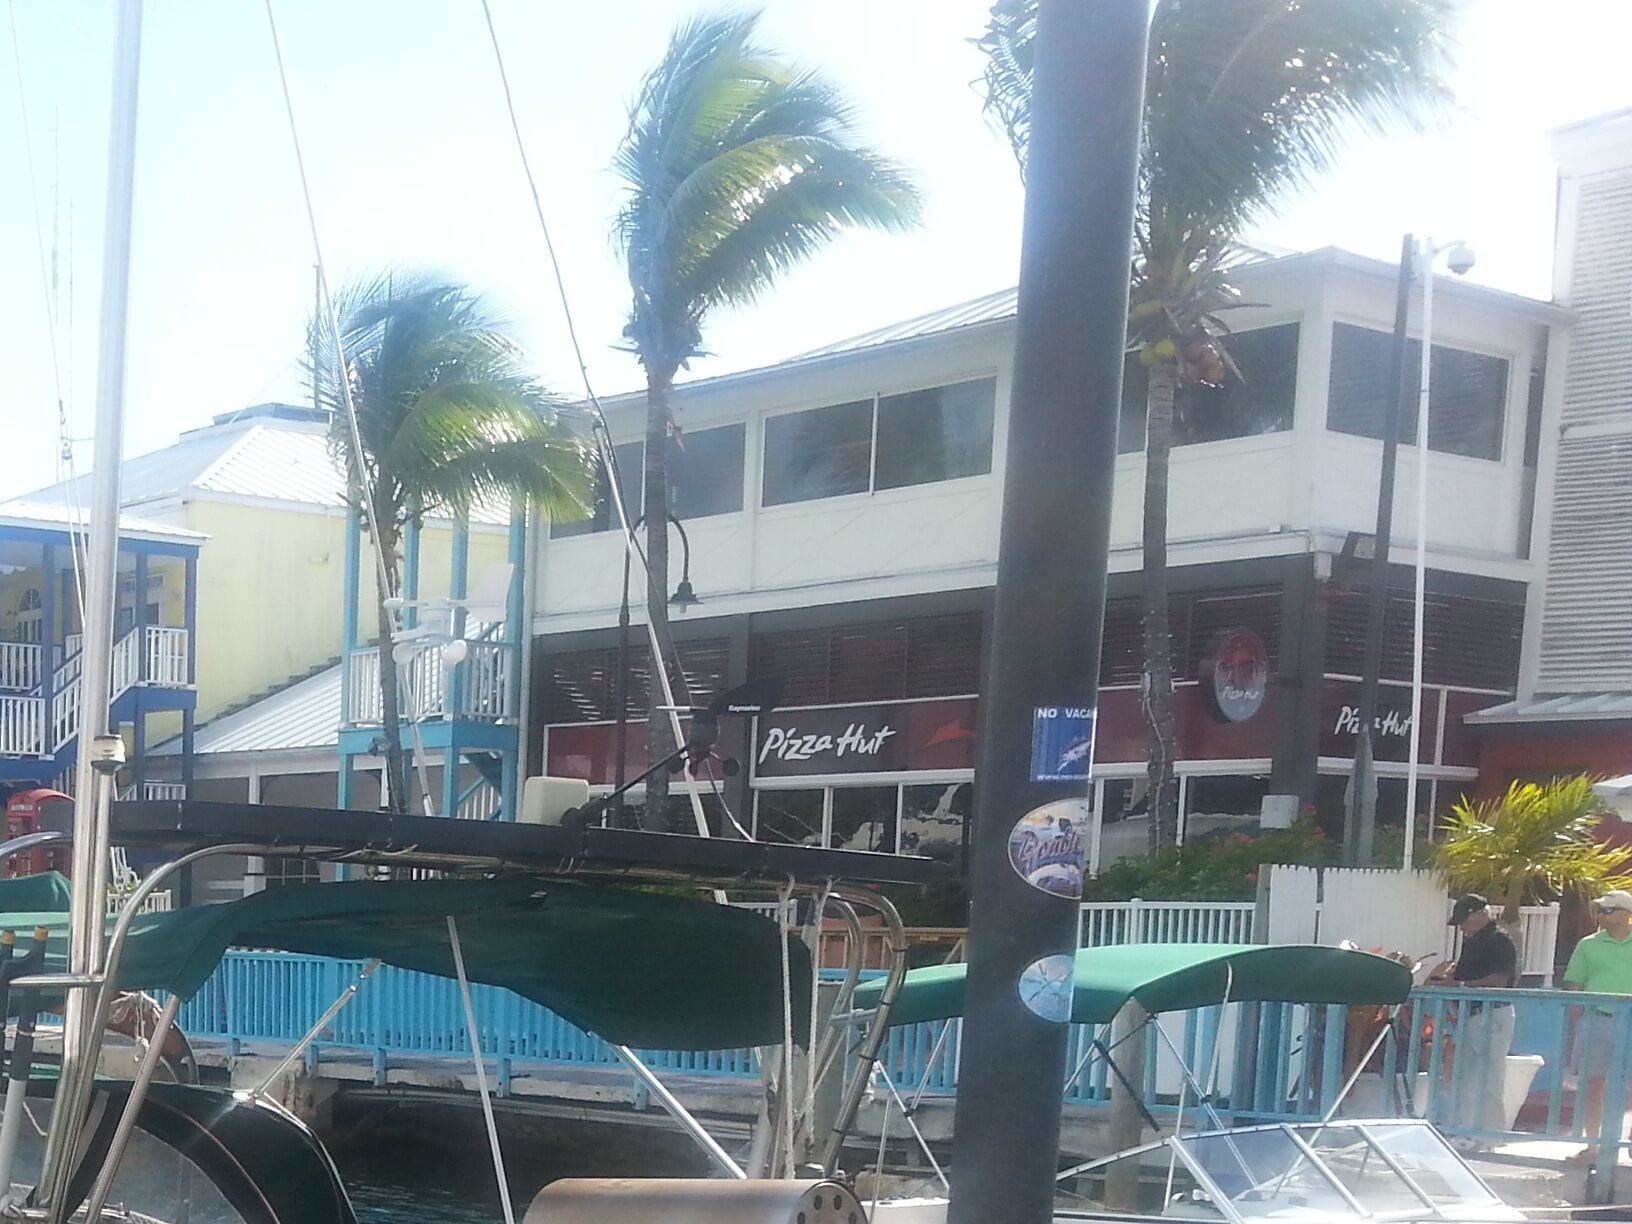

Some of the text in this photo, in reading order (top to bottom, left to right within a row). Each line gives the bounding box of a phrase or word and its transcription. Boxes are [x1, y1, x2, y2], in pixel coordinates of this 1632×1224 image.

[1037, 708, 1093, 719] NO VACA
[759, 723, 896, 765] Pizza Hut
